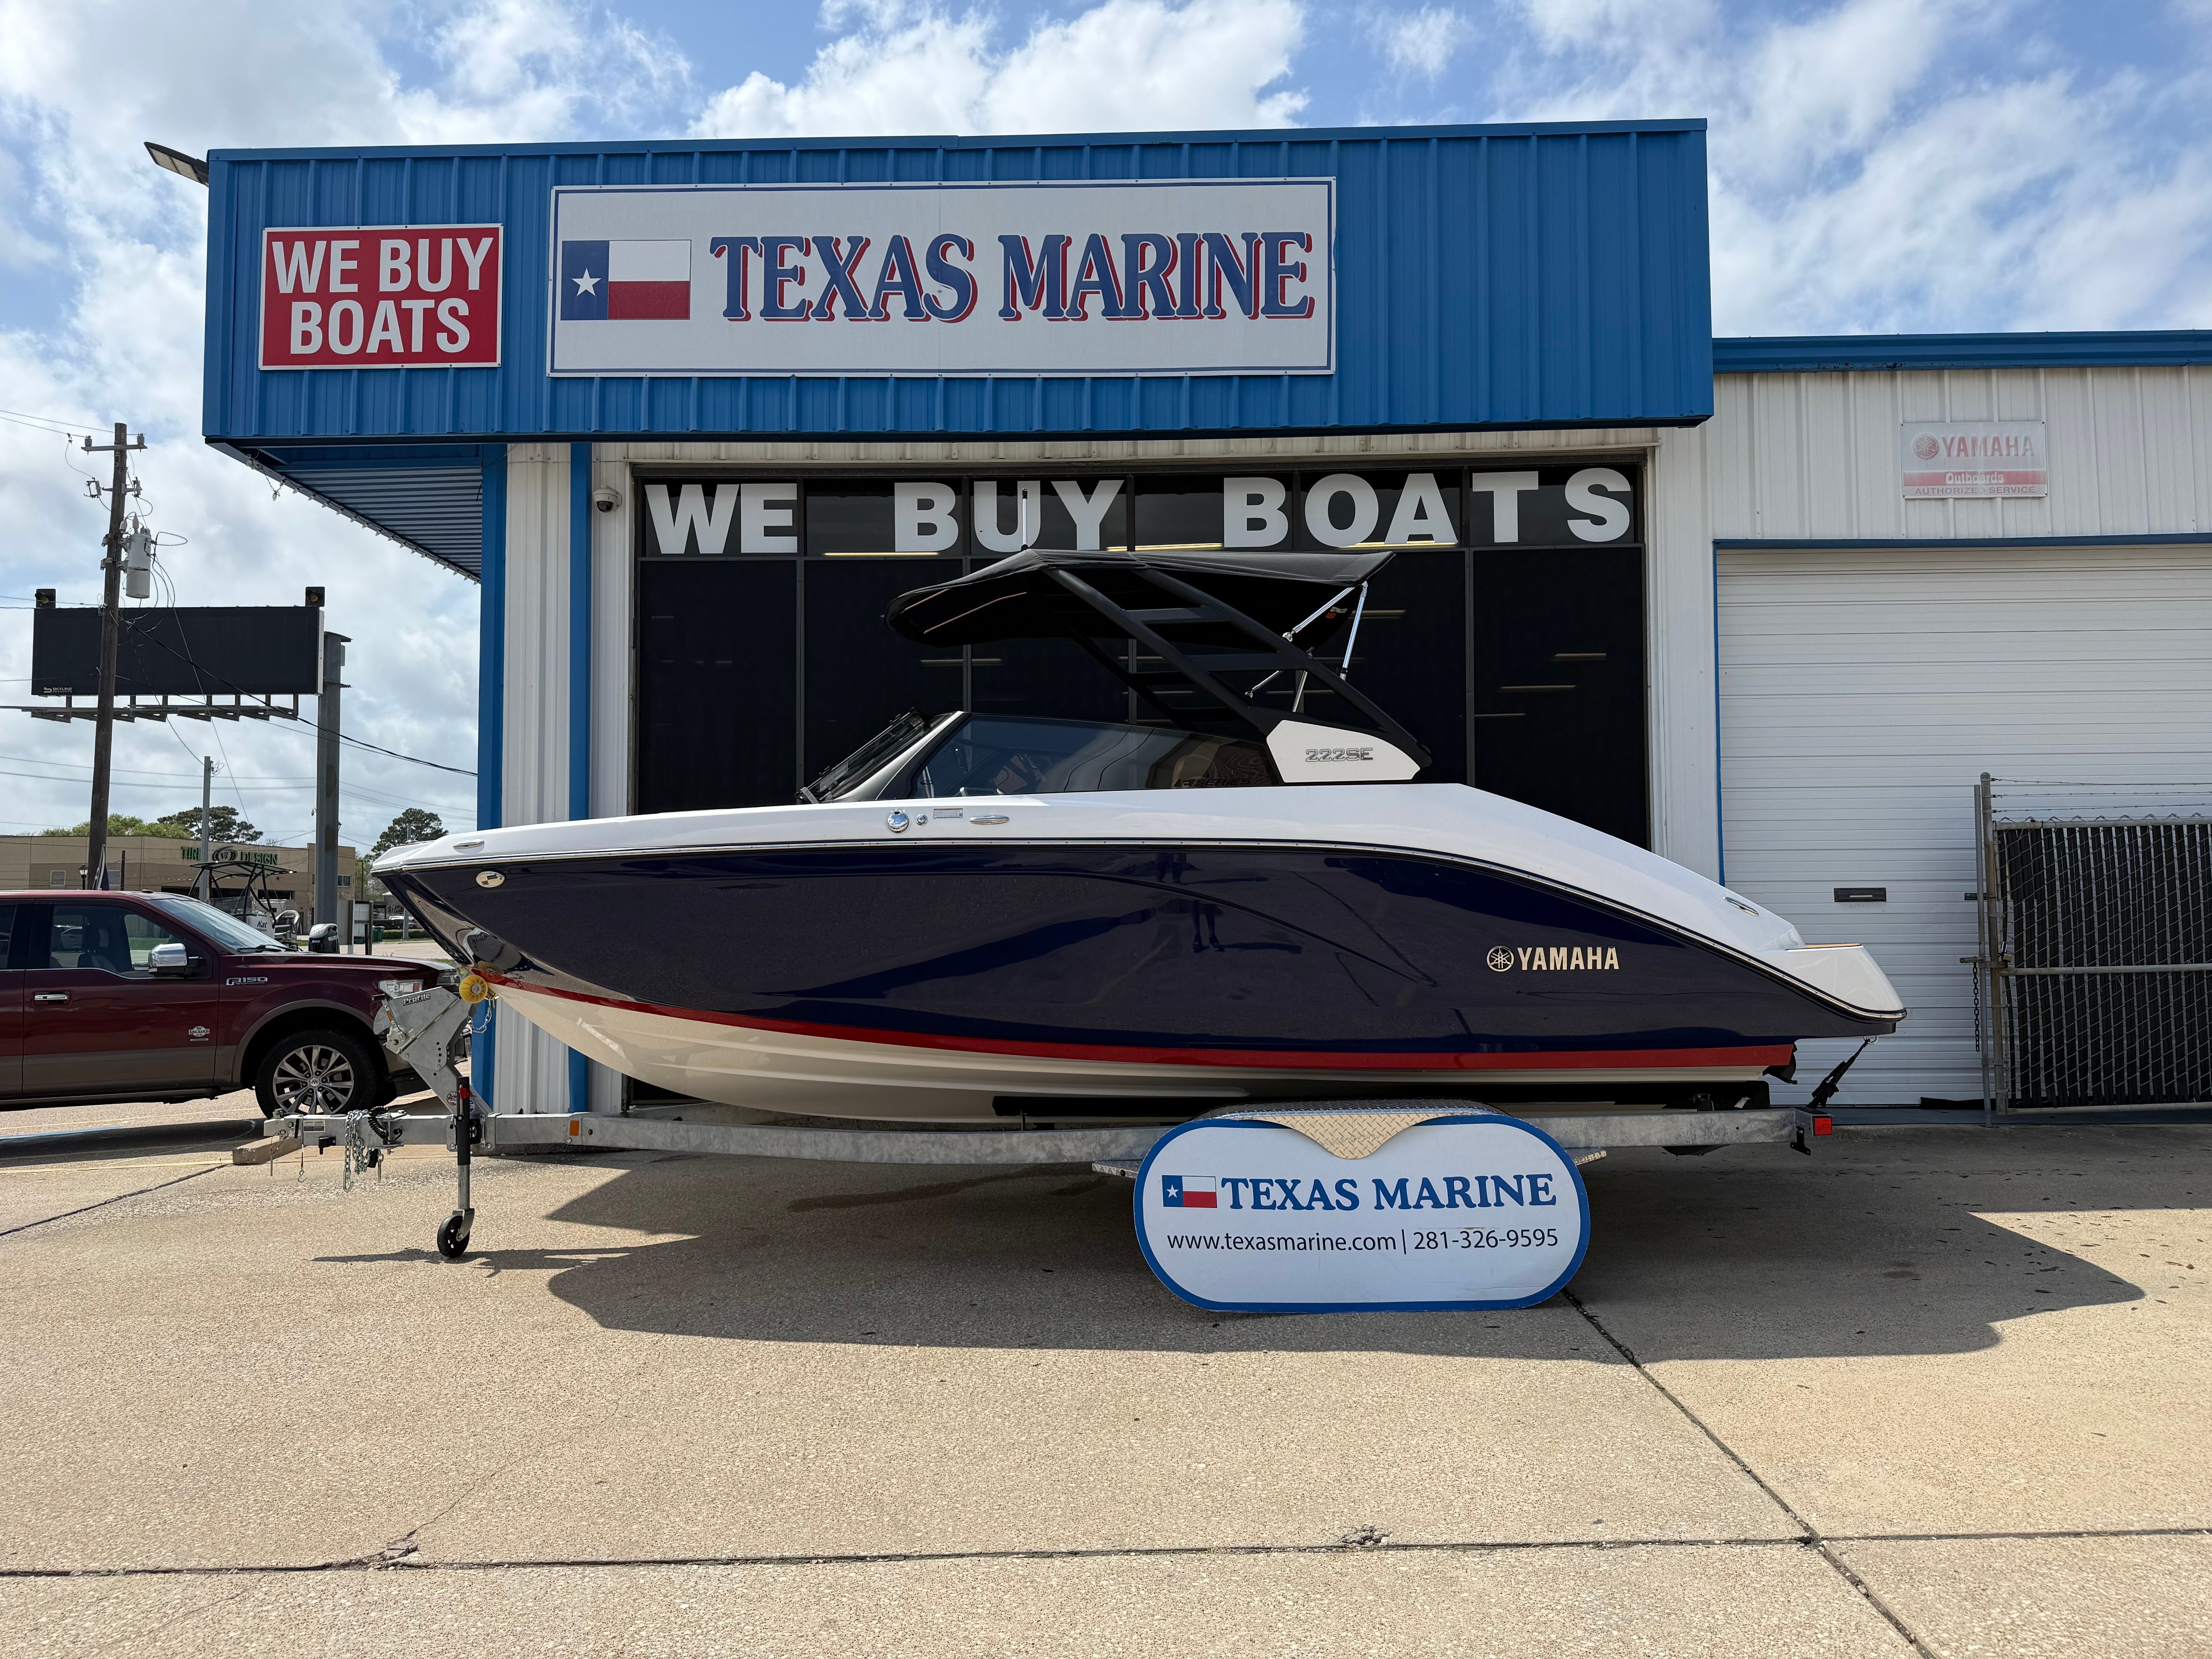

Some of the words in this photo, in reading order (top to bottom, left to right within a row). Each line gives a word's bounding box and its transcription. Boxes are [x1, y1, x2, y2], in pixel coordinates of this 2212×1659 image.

[272, 239, 360, 294] WE
[379, 237, 494, 292] BUY
[709, 234, 978, 323] TEXAS
[998, 232, 1316, 321] MARINE
[290, 298, 470, 355] BOATS
[1941, 436, 2035, 457] YAMAHA
[1946, 472, 2004, 484] Outboards
[644, 483, 798, 554] WE
[894, 480, 1125, 553] BUY
[1223, 468, 1632, 548] BOATS
[1305, 747, 1374, 762] 222SE
[241, 852, 278, 865] DESIGN
[1517, 946, 1619, 970] YAMAHA
[404, 994, 430, 1003] Profile
[1221, 1177, 1360, 1211] TEXAS
[1372, 1173, 1556, 1209] MARINE
[1167, 1231, 1396, 1252] www.texasmarine.com
[1413, 1228, 1558, 1250] 281-326-9595
